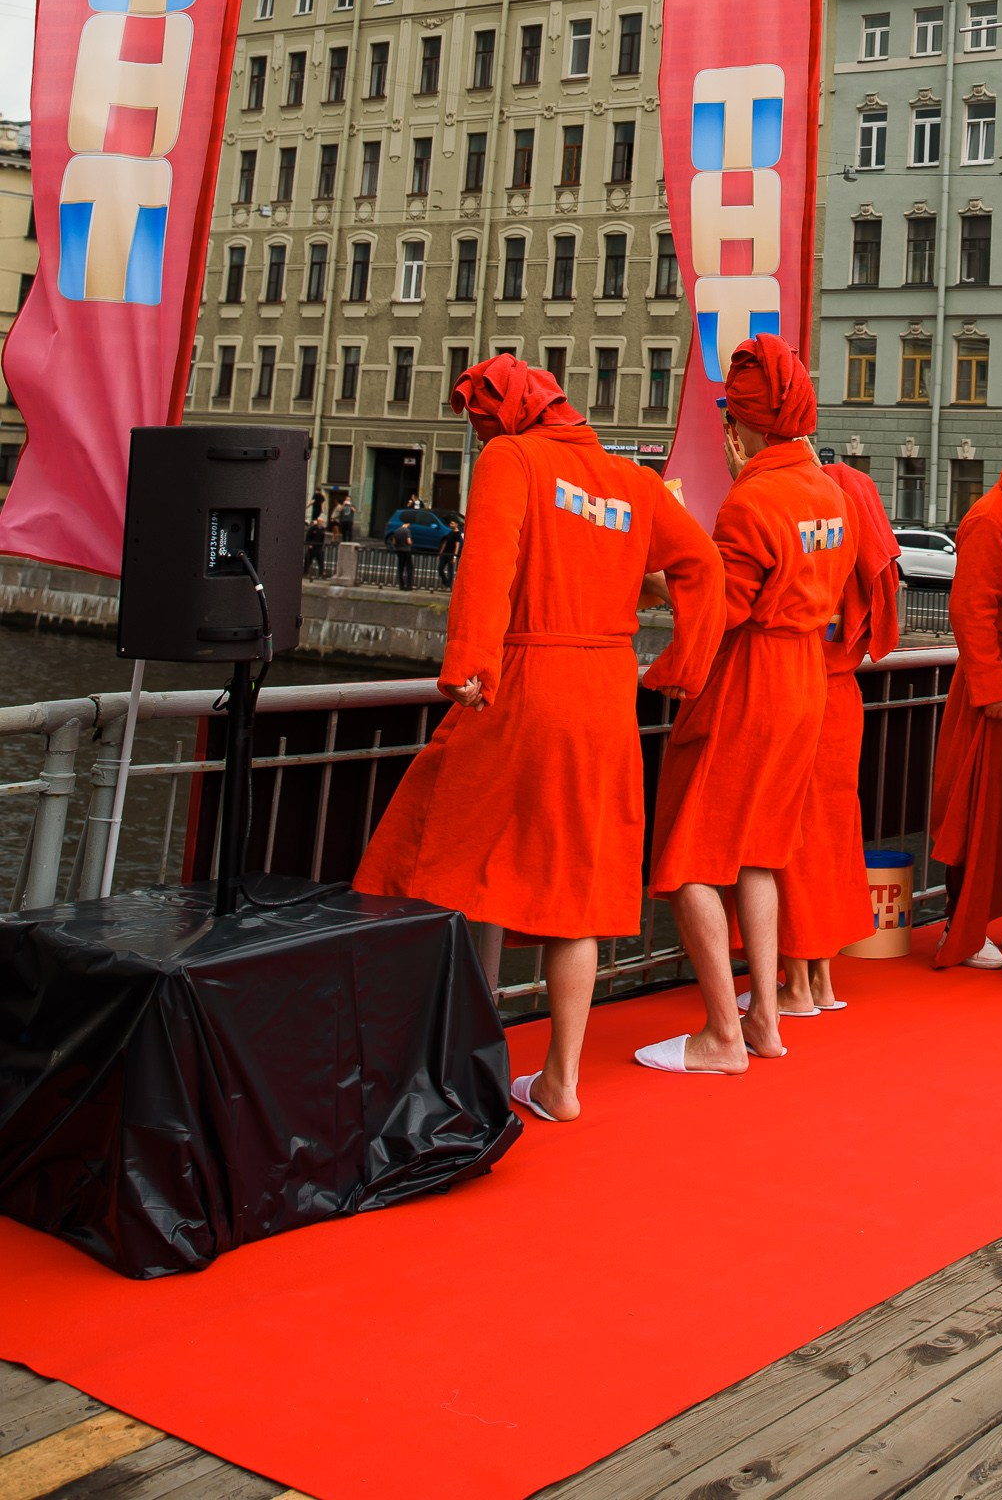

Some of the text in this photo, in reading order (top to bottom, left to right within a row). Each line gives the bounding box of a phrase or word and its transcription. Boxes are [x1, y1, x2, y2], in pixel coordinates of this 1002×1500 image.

[691, 64, 785, 382] ТНТ
[555, 478, 632, 533] ТНТ
[798, 517, 844, 553] ТНТ
